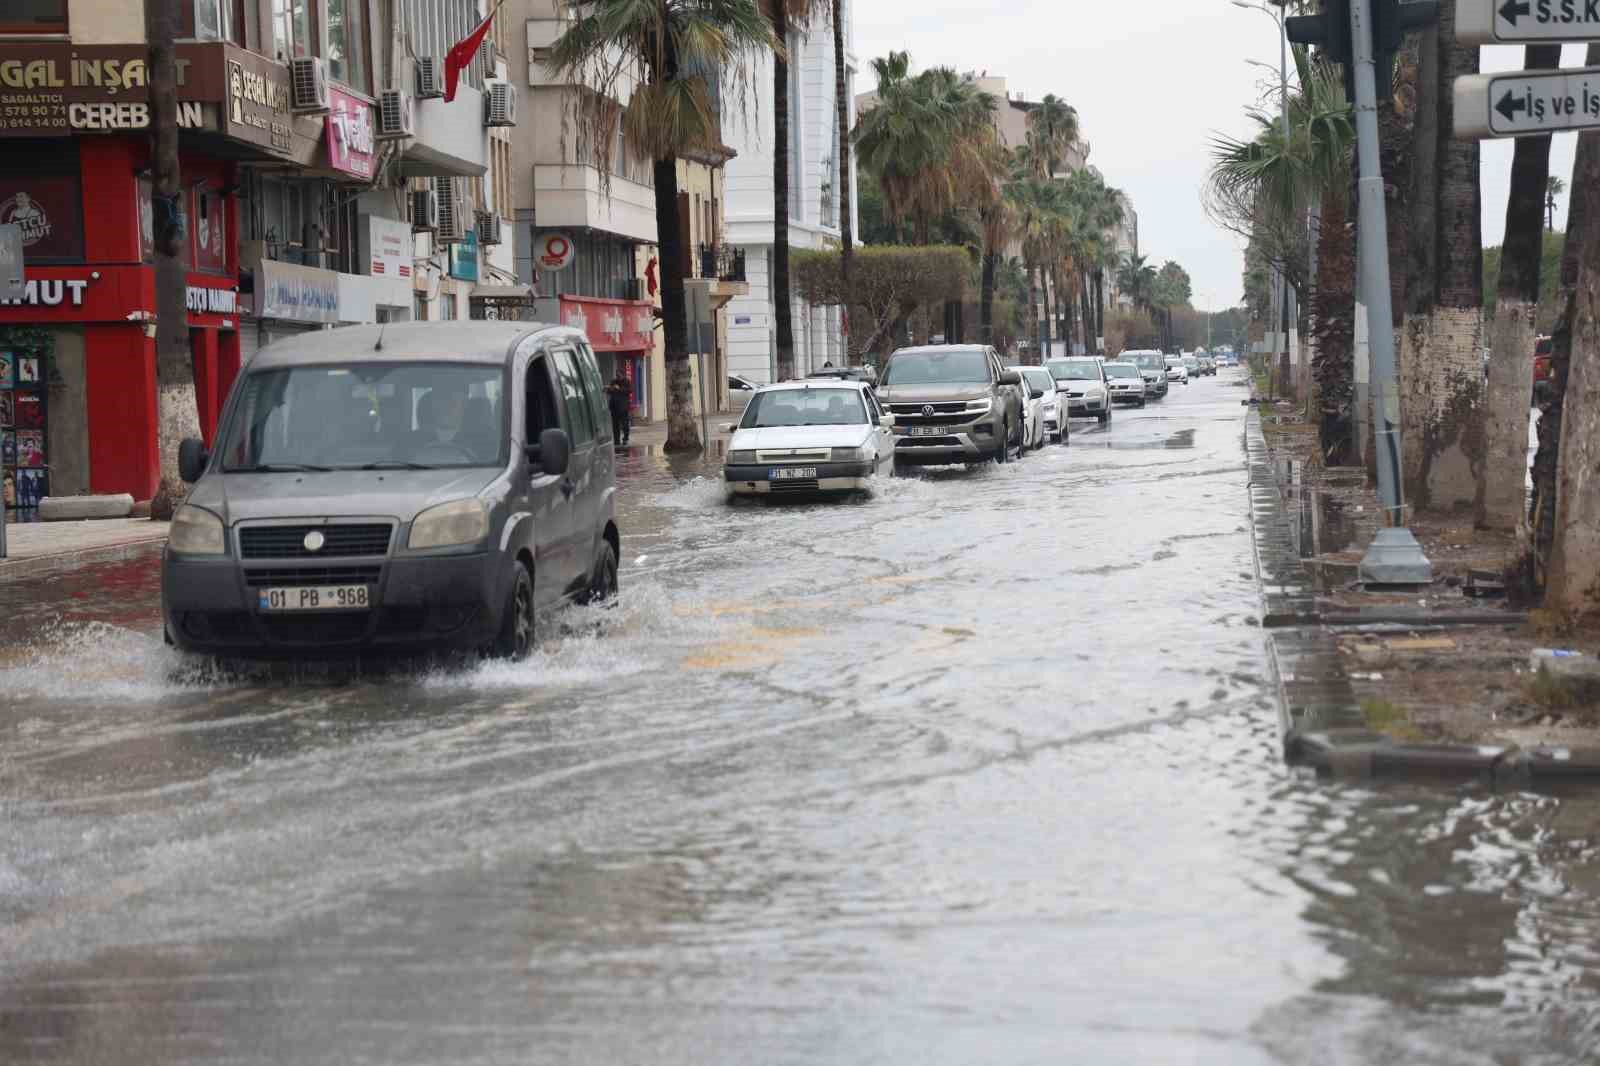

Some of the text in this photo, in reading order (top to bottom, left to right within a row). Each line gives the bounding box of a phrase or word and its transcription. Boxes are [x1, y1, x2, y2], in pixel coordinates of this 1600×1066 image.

[71, 52, 191, 94] İNŞAT
[69, 101, 203, 129] CEREBAN
[1551, 95, 1576, 116] ve
[270, 587, 367, 608] 01 PB 968
